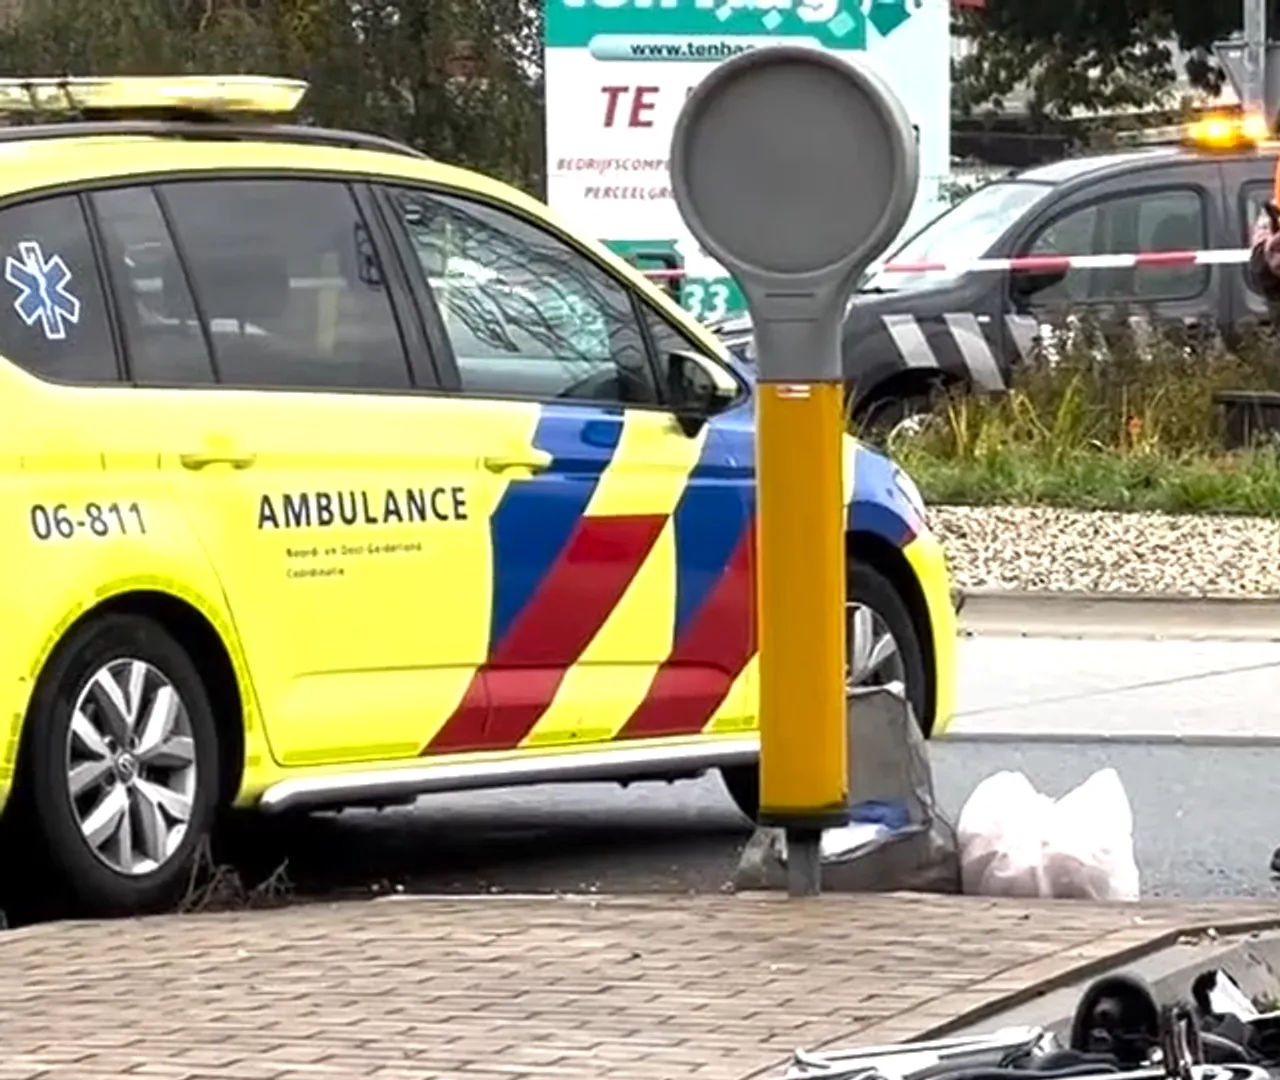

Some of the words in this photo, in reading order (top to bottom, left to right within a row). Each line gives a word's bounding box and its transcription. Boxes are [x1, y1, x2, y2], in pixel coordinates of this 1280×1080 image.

[601, 86, 660, 127] TE
[31, 502, 146, 540] 06-811
[258, 486, 468, 529] AMBULANCE
